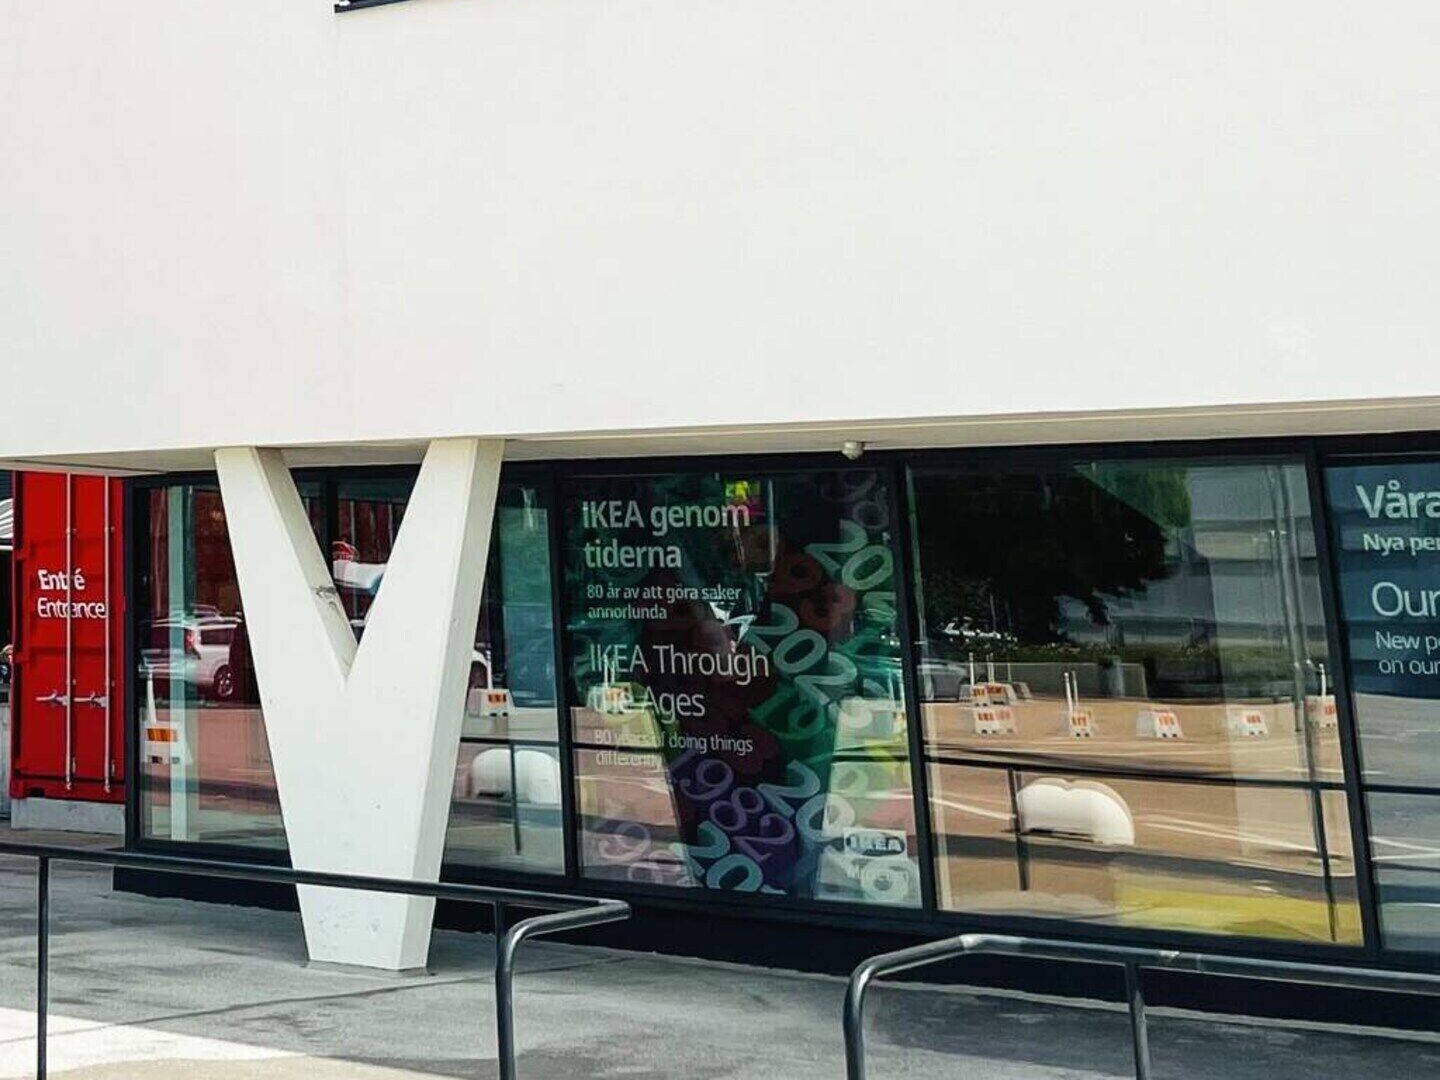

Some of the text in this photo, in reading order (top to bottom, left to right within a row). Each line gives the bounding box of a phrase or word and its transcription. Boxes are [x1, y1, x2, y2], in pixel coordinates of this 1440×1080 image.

[1355, 479, 1440, 518] Våra
[582, 500, 751, 537] IKEA genom
[584, 539, 683, 569] tiderna
[1363, 533, 1405, 557] Nya
[38, 568, 86, 590] Enté
[587, 581, 742, 604] 80 år av att göra saker
[1372, 581, 1440, 617] Our
[37, 597, 110, 619] Entrance
[587, 603, 668, 620] annorlunda
[1375, 630, 1420, 649] New
[589, 643, 770, 686] IKEA Through
[1378, 659, 1404, 674] on
[643, 685, 706, 724] Ages
[668, 732, 708, 754] doing
[710, 734, 754, 757] things
